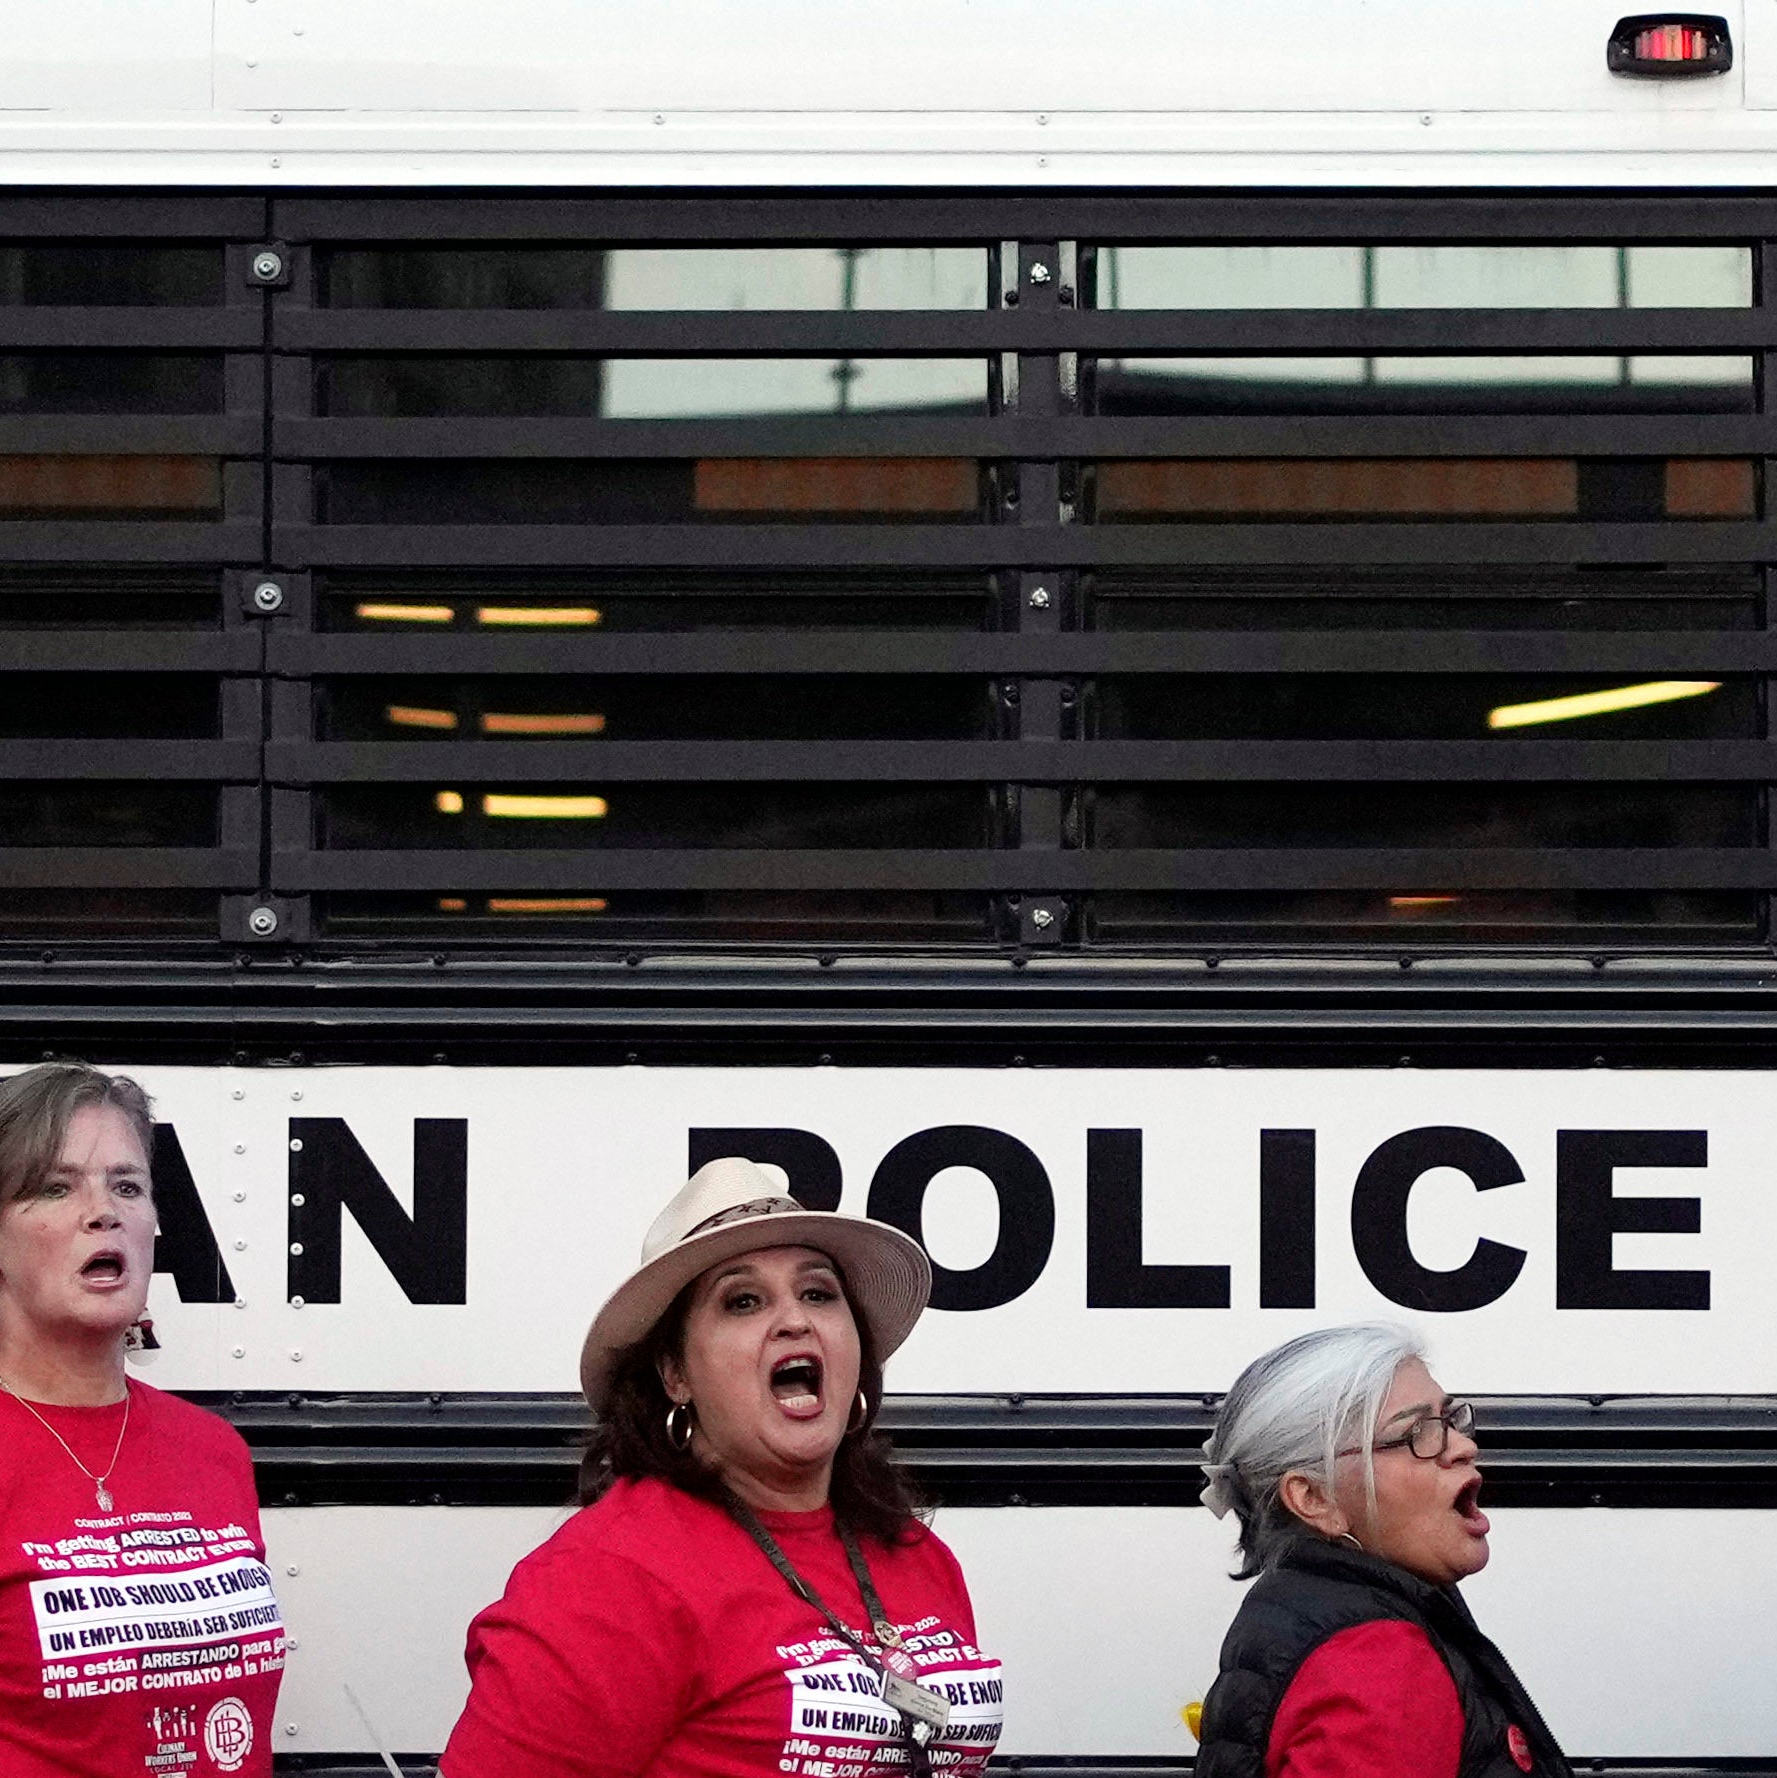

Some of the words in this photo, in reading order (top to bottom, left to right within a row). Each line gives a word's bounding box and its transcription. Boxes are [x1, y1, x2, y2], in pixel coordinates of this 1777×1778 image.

[74, 1516, 124, 1529] CONTRACT
[22, 1541, 54, 1556] I'm
[55, 1533, 121, 1556] getting
[120, 1527, 200, 1548] ARRESTED
[201, 1526, 218, 1541] to
[218, 1522, 248, 1538] win
[38, 1556, 71, 1571] the
[71, 1554, 119, 1570] BEST
[122, 1547, 206, 1568] CONTRACT
[44, 1587, 89, 1614] ONE
[90, 1586, 127, 1609] JOB
[125, 1582, 195, 1606] SHOULD
[193, 1576, 221, 1600] BE
[49, 1632, 76, 1652] UN
[80, 1623, 144, 1647] EMPLEO
[205, 1615, 228, 1634] SER
[42, 1665, 78, 1683] ¡Me
[83, 1657, 137, 1676] están
[141, 1643, 239, 1670] ARRESTANDO
[241, 1640, 271, 1660] para
[913, 1648, 961, 1667] RACT
[43, 1683, 61, 1699] el
[67, 1677, 138, 1699] MEJOR
[141, 1669, 221, 1690] CONTRATO
[224, 1663, 242, 1680] de
[244, 1660, 257, 1675] la
[848, 1672, 880, 1698] JOB
[945, 1682, 968, 1706] BE
[802, 1708, 827, 1728] UN
[832, 1711, 886, 1736] EMPLEO
[943, 1724, 967, 1741] SER
[825, 1744, 870, 1760] están
[872, 1748, 962, 1765] ARRENDO
[779, 1758, 797, 1772] el
[802, 1760, 863, 1778] MEJOR
